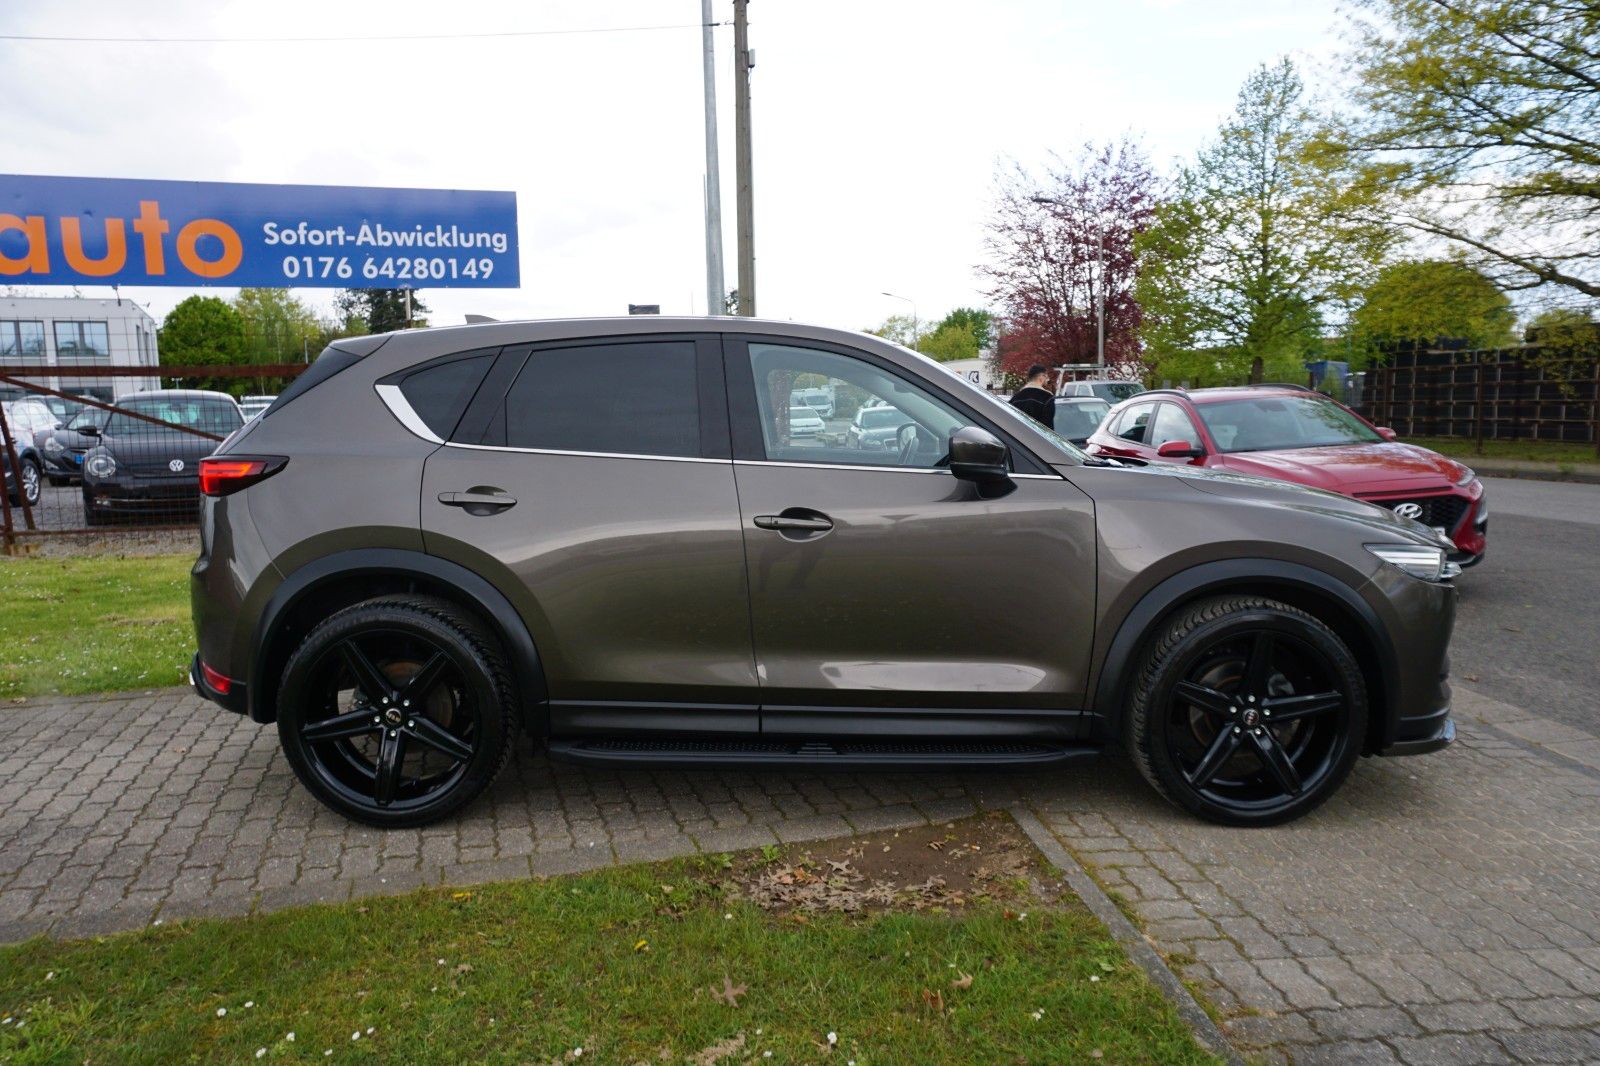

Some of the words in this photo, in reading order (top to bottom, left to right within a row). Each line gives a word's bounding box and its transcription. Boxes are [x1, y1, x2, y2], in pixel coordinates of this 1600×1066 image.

[0, 201, 242, 277] auto
[263, 222, 507, 253] Sofort-Abwicklung
[283, 257, 353, 279] 0176
[362, 257, 494, 279] 64280149
